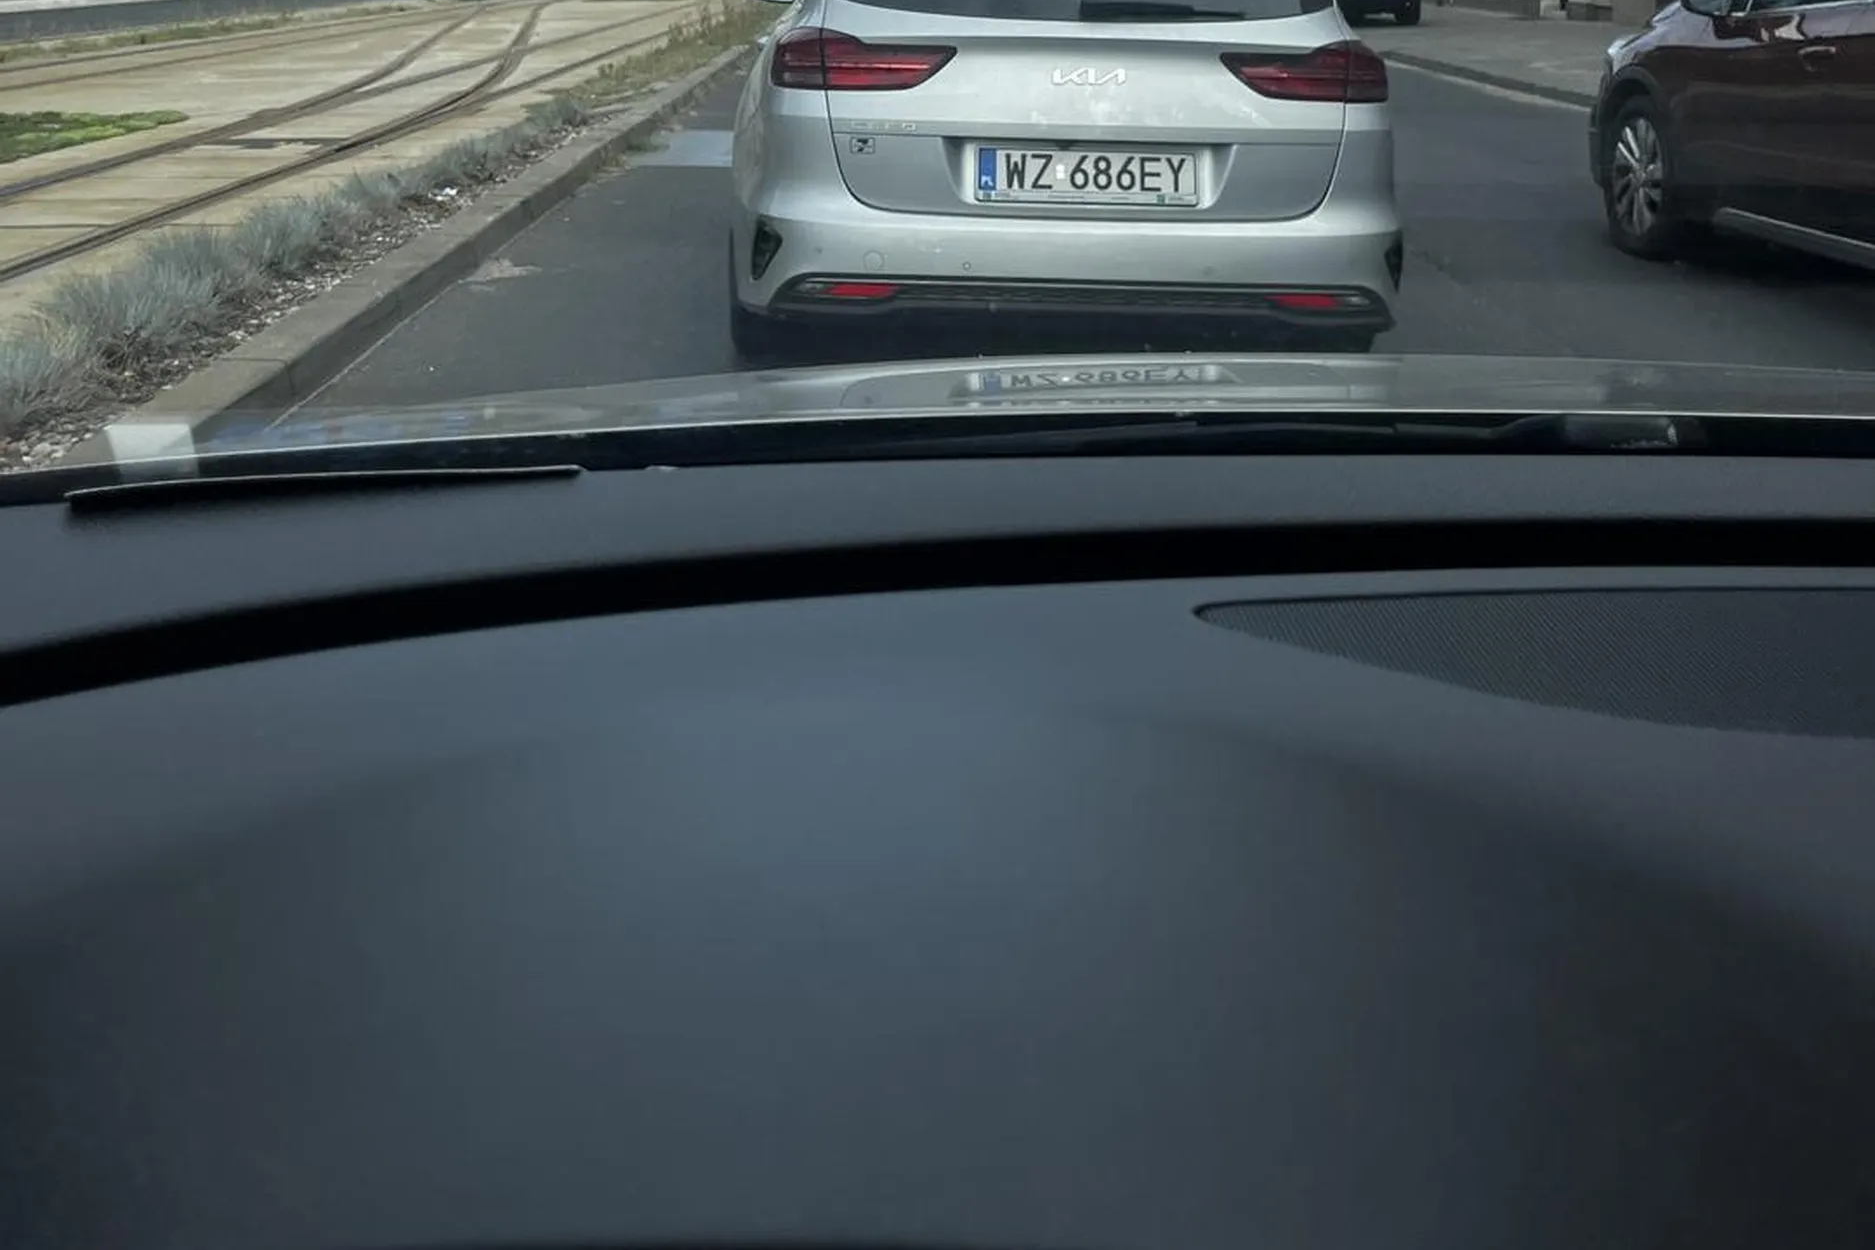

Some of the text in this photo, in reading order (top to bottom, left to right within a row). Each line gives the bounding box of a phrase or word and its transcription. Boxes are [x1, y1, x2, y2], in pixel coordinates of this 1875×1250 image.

[1052, 68, 1126, 85] KIA
[1004, 152, 1187, 193] WZ 686EY
